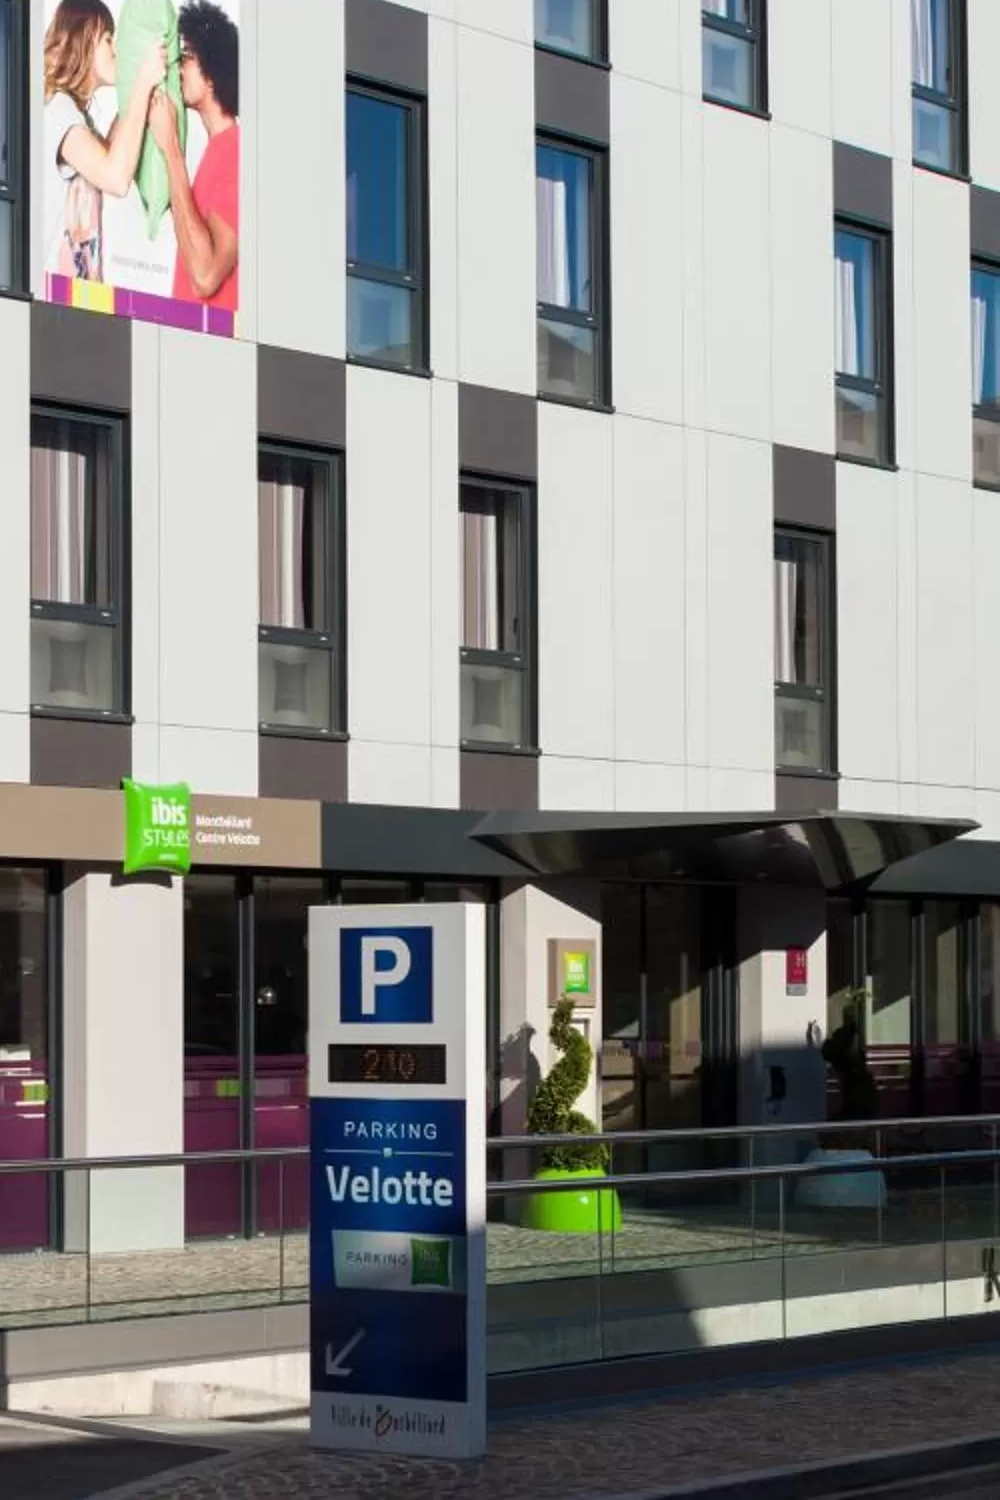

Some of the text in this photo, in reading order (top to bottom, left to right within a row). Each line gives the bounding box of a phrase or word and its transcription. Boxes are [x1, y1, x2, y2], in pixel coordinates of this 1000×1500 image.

[151, 796, 187, 826] ibis
[360, 936, 412, 1015] P
[344, 1121, 438, 1141] PARKING
[326, 1165, 454, 1207] Velotte
[346, 1251, 408, 1267] PARKING
